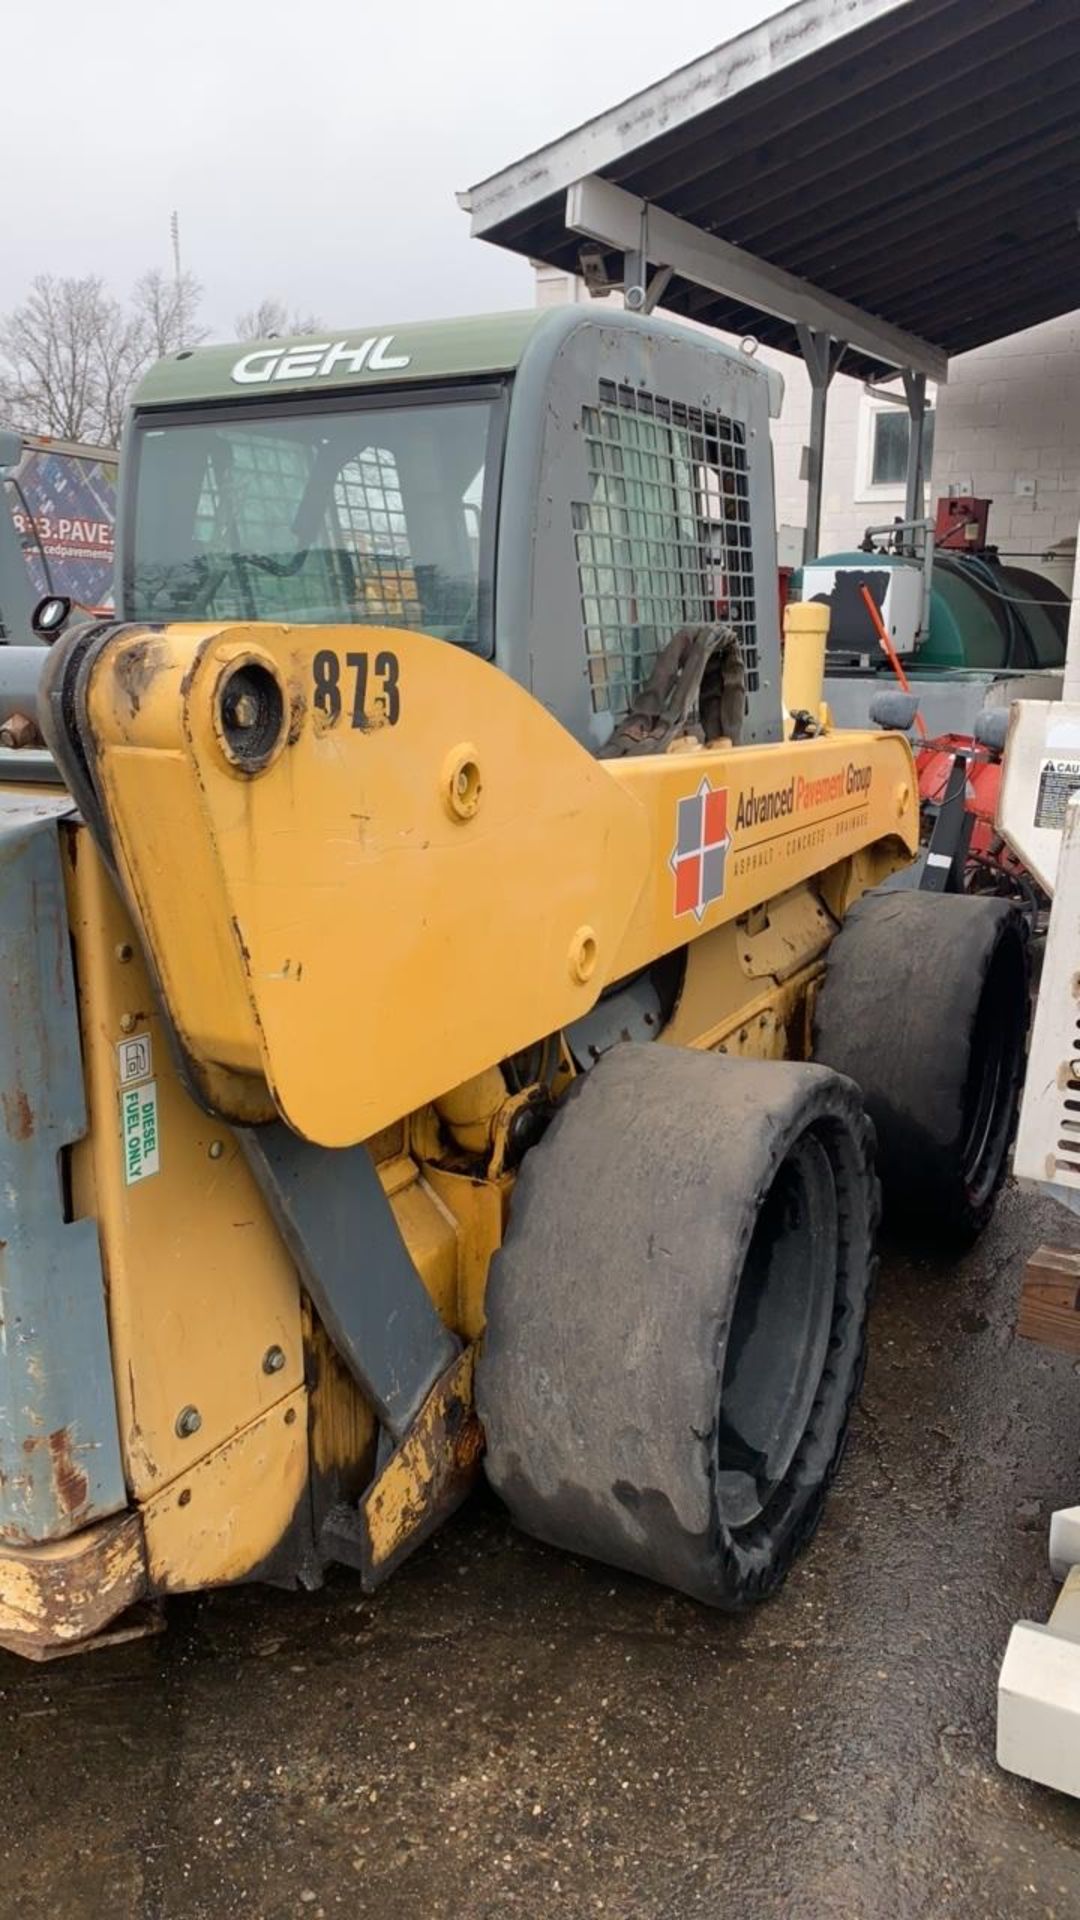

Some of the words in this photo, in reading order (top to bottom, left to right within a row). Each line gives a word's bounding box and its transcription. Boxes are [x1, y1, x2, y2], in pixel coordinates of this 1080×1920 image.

[231, 335, 411, 384] GEHL
[313, 649, 400, 729] 873
[1056, 762, 1080, 774] CAU
[735, 776, 795, 831] Advanced
[795, 766, 845, 813] Pavement
[845, 763, 872, 799] Group
[733, 847, 774, 876] ASPHALT
[786, 828, 825, 856] CONCRETE
[126, 1092, 140, 1135] FUEL
[142, 1102, 156, 1158] DIESEL
[128, 1137, 142, 1177] ONLY
